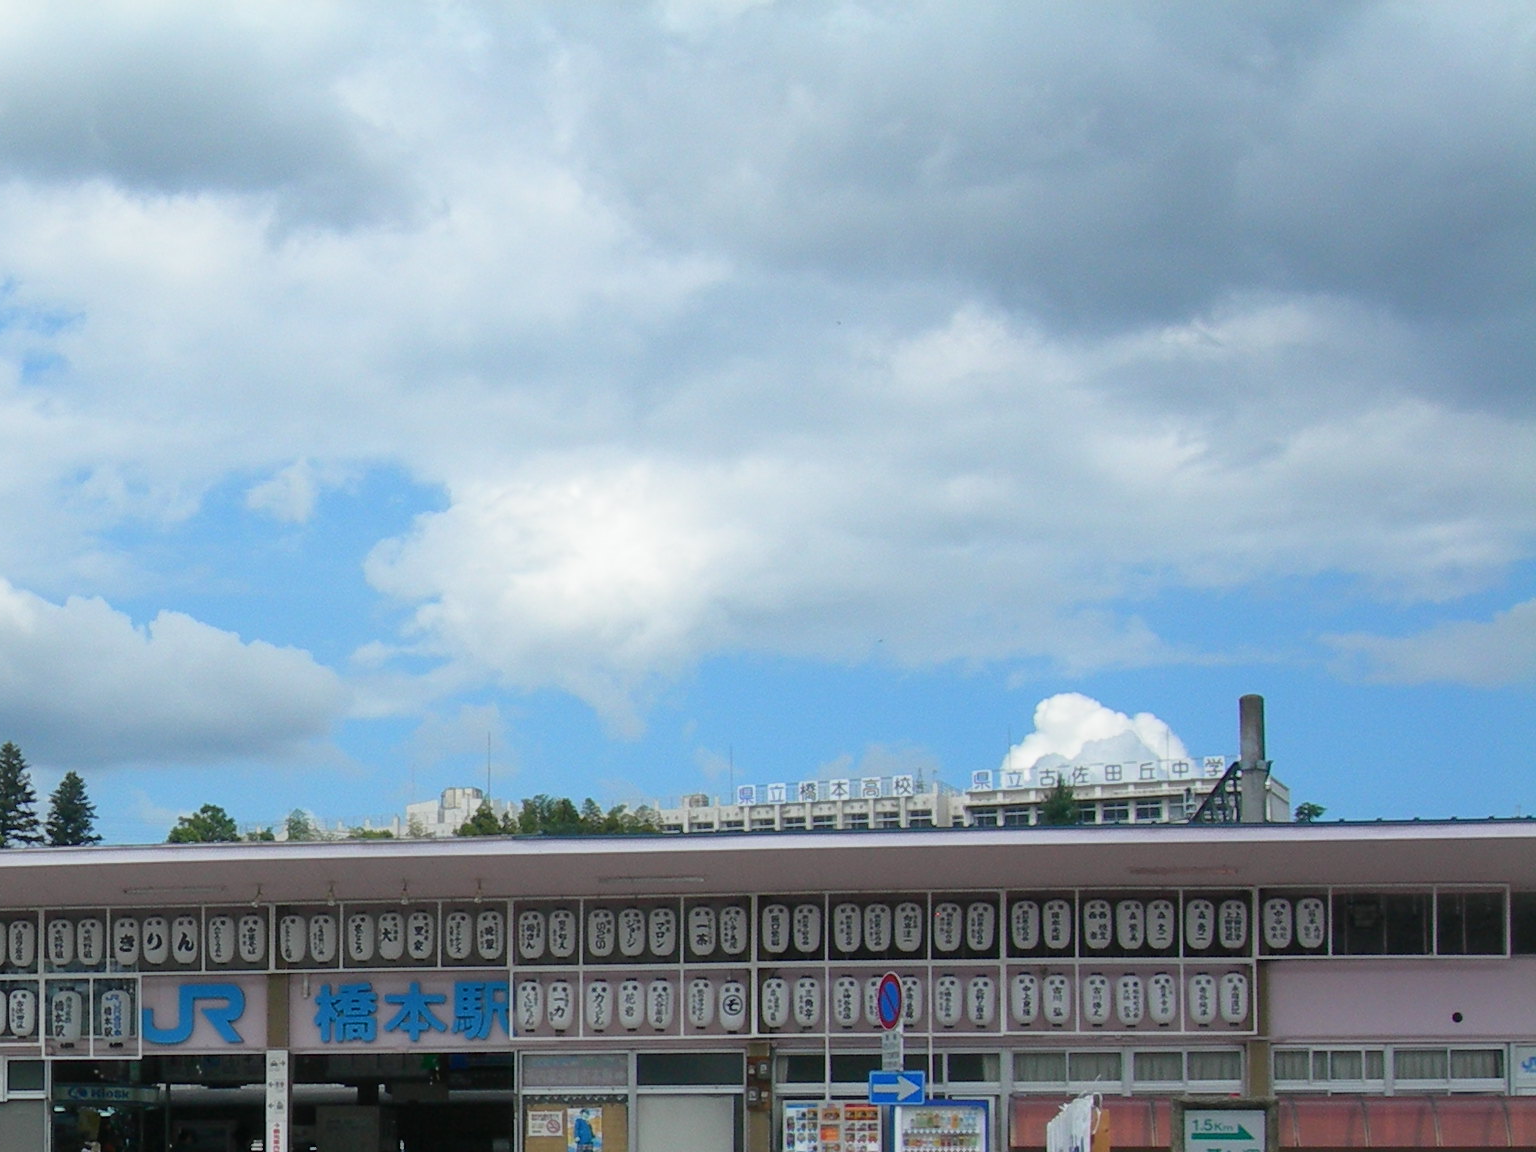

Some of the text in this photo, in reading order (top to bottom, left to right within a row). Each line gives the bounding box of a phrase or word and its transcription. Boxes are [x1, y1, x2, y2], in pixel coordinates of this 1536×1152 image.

[973, 759, 1222, 789] 県立古佐田丘中学
[740, 777, 911, 804] 県立橋本高校
[119, 933, 195, 953] きりん
[141, 984, 246, 1045] JR
[314, 980, 510, 1044] 橋本駅
